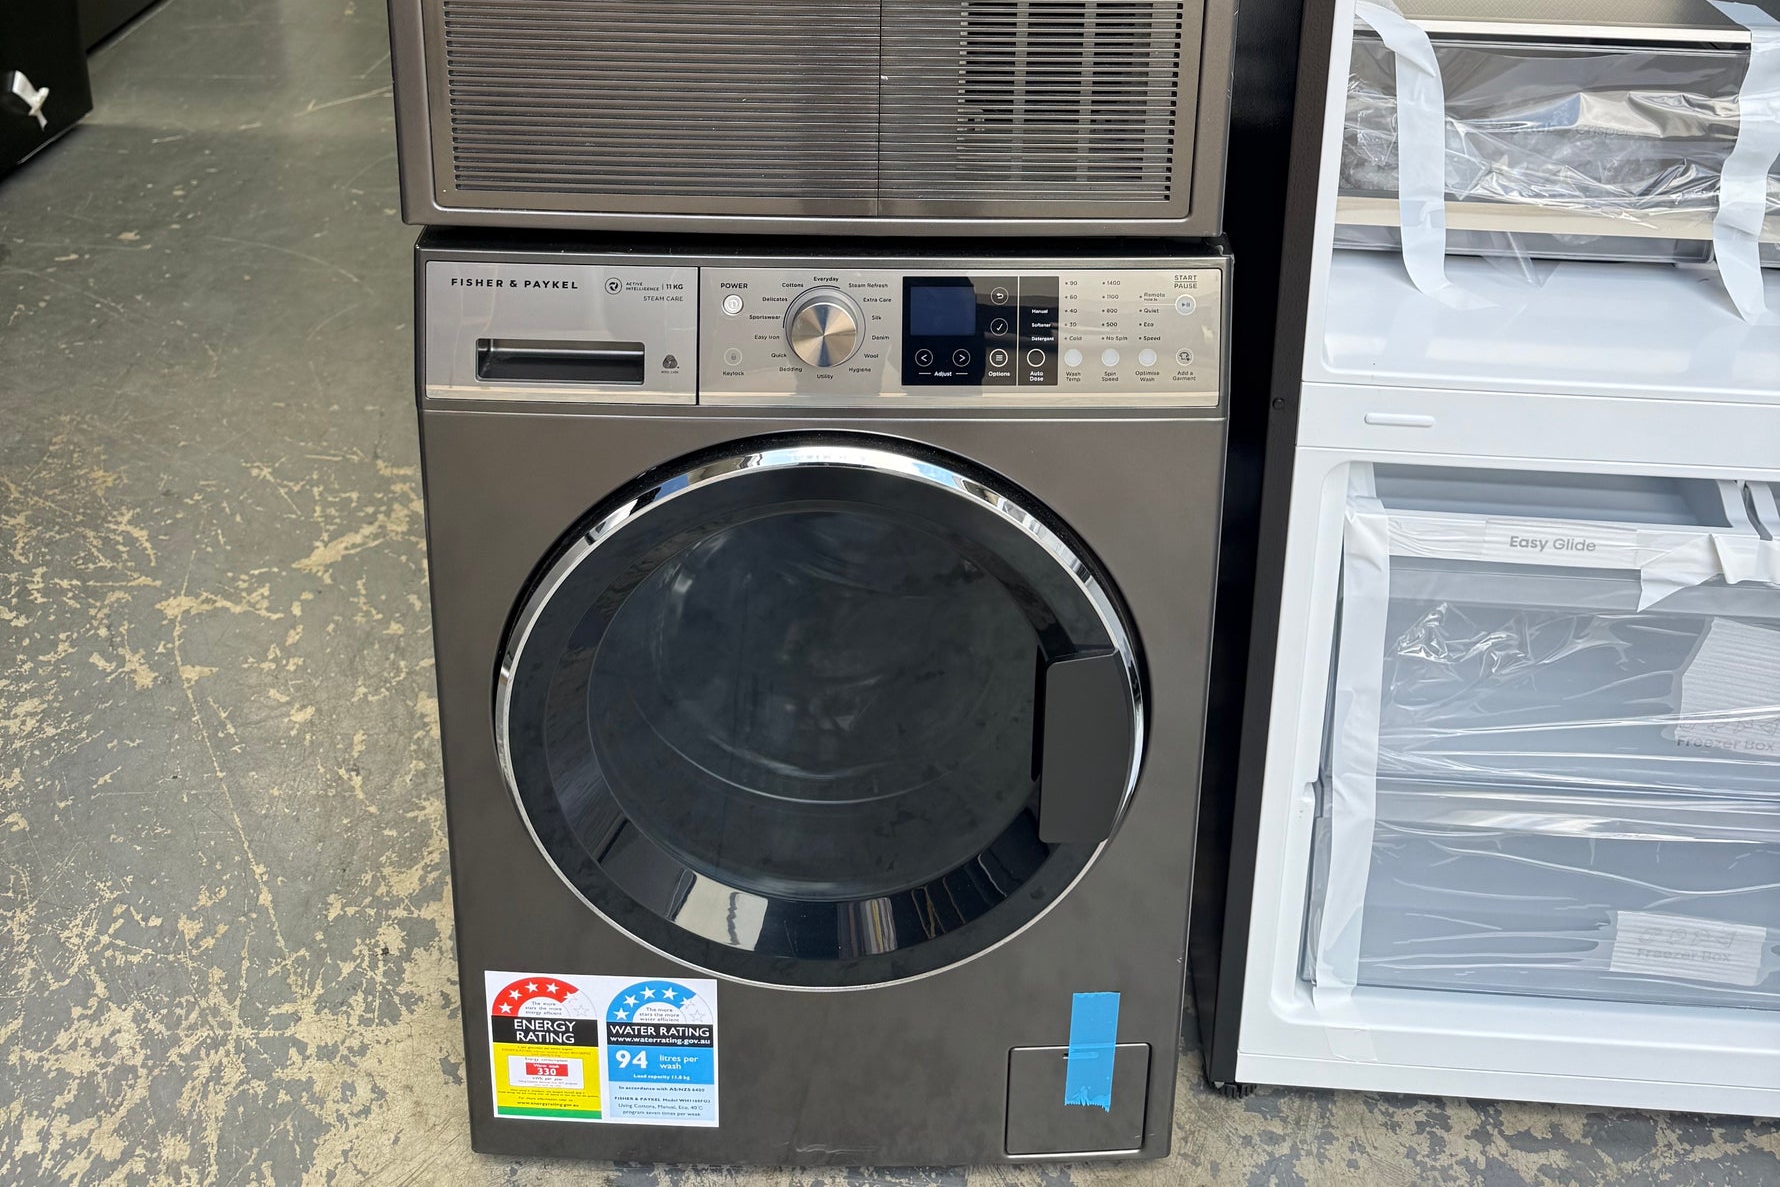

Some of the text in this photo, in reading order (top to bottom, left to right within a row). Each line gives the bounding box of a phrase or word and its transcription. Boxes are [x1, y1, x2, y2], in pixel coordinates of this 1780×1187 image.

[451, 278, 579, 290] FISHER & PAYKEL
[933, 370, 953, 378] Adjust
[1509, 535, 1597, 552] Easy Glide
[1676, 737, 1775, 751] Freezer Box
[1635, 948, 1731, 962] Freezer Box
[514, 1018, 576, 1032] ENERGY
[610, 1025, 710, 1037] WATER RATING
[516, 1031, 575, 1044] RATING
[610, 1036, 711, 1045] www.waterrating.gov.au
[615, 1049, 649, 1069] 94
[683, 1056, 699, 1064] per
[537, 1067, 557, 1076] 330
[660, 1062, 681, 1070] wash
